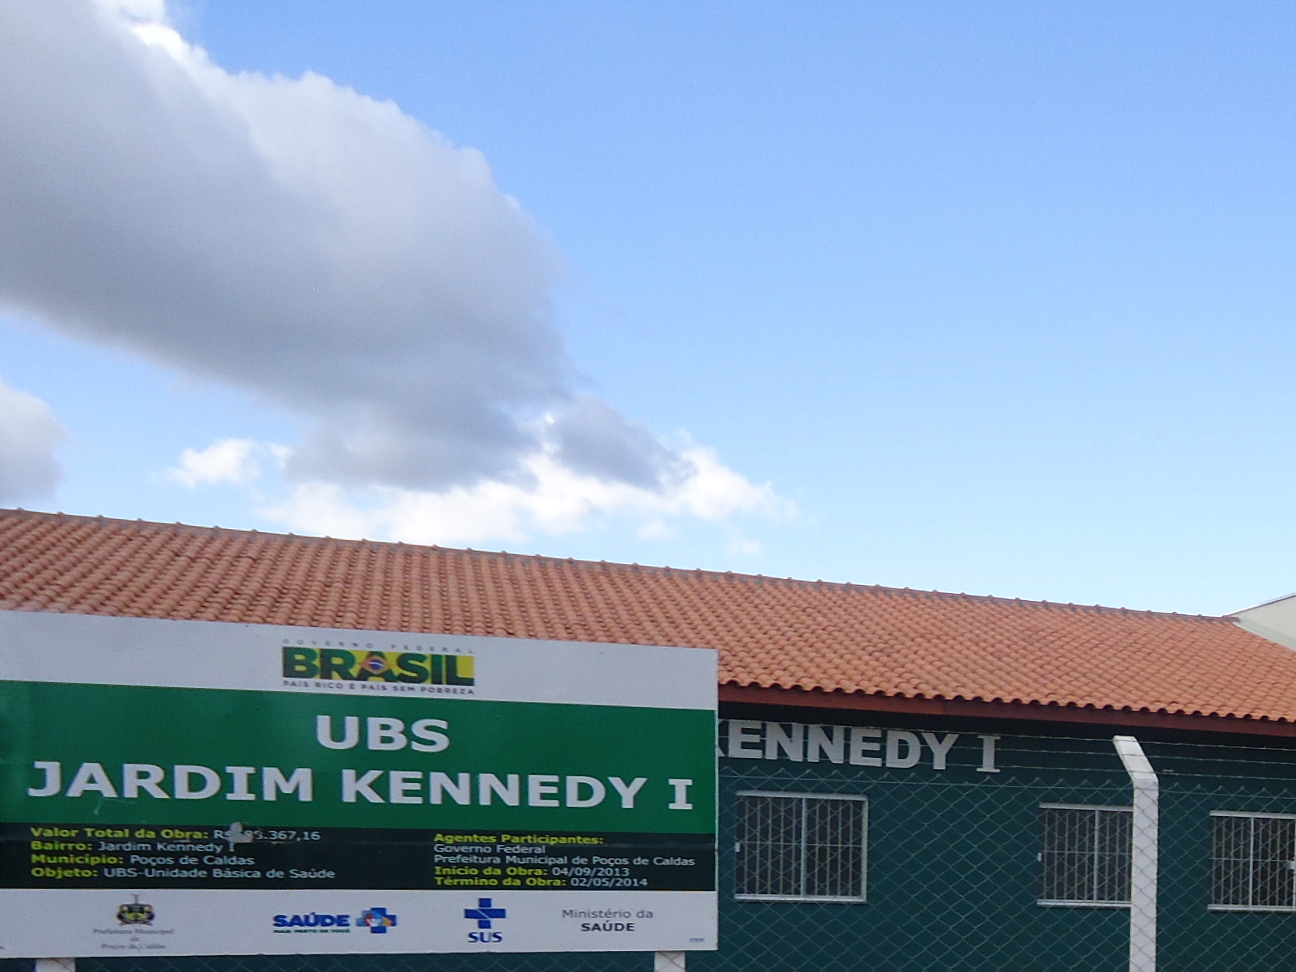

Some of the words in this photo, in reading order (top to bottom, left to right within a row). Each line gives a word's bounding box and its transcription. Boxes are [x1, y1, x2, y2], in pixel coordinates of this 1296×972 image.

[282, 645, 475, 687] BRASIL
[314, 681, 344, 690] RICO
[393, 685, 416, 693] SEM
[420, 686, 475, 695] POBREZA
[316, 715, 450, 753] UBS
[718, 719, 959, 771] ENNEDY
[976, 735, 1001, 773] I
[27, 760, 313, 802] JARDIM
[341, 769, 648, 809] KENNEDY
[668, 778, 693, 810] I
[30, 826, 79, 838] Valor
[83, 827, 130, 838] Total
[134, 828, 156, 839] da
[160, 828, 209, 840] Obra:
[433, 833, 497, 844] Agentes
[501, 834, 604, 845] Participantes:
[31, 840, 93, 851] Bairro:
[97, 841, 151, 851] Jardim
[156, 842, 224, 854] Kennedy
[433, 843, 492, 853] Governo
[496, 844, 546, 854] Federal
[31, 853, 124, 866] Município:
[129, 854, 175, 866] Poços
[179, 855, 199, 865] de
[202, 855, 256, 866] Caldas
[433, 854, 501, 864] Prefeitura
[505, 855, 567, 866] Municipal
[571, 855, 589, 865] de
[592, 856, 629, 866] Poços
[632, 856, 650, 865] de
[653, 856, 696, 866] Caldas
[31, 867, 99, 879] Objeto:
[103, 867, 208, 878] UBS-Unidade
[212, 868, 262, 879] Básica
[265, 868, 285, 879] de
[288, 868, 336, 879] Saúde
[434, 865, 479, 875] Início
[482, 866, 502, 876] da
[505, 866, 548, 876] Obra:
[551, 867, 630, 877] 04/09/2013
[434, 876, 499, 886] Término
[502, 877, 522, 886] da
[525, 877, 567, 887] Obra:
[570, 877, 649, 887] 02/05/2014
[273, 911, 350, 928] SAÚDE
[561, 907, 632, 919] Ministério
[635, 908, 654, 919] da
[580, 919, 636, 932] SAÚDE
[467, 931, 504, 944] SUS
